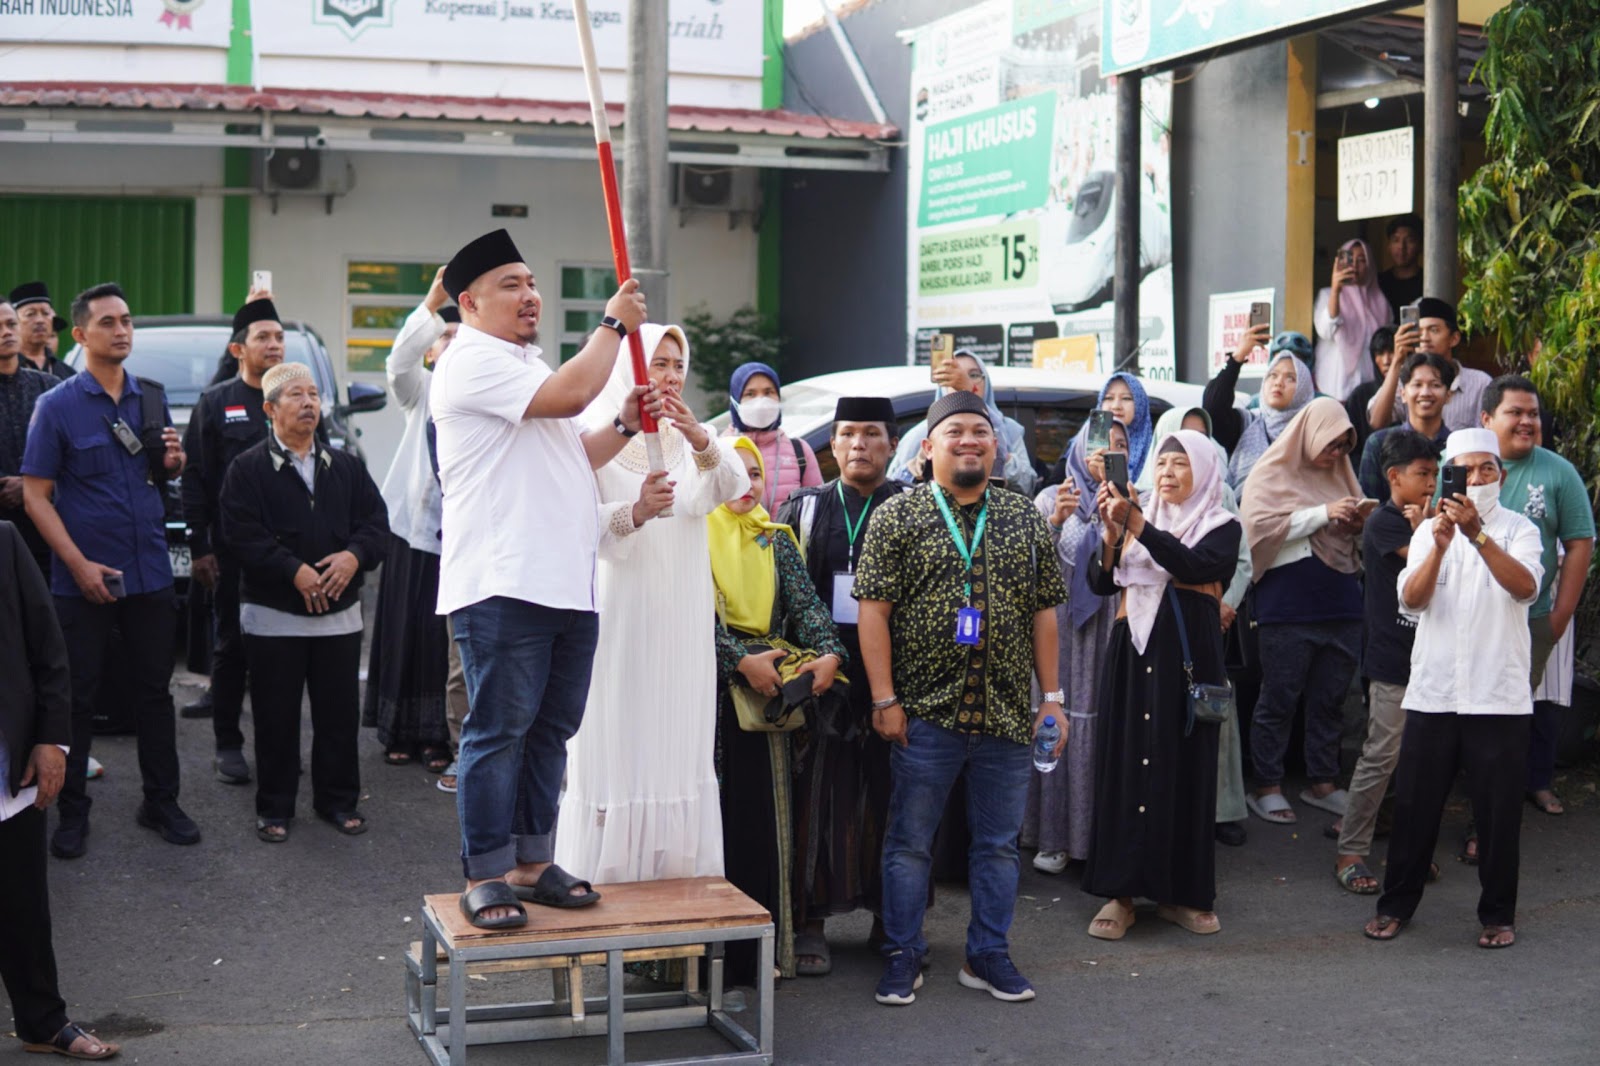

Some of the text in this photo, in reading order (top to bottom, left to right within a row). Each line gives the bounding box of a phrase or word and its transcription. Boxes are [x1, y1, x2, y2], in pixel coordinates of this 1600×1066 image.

[0, 0, 133, 17] RAH INDONESIA
[425, 0, 621, 28] Koperasi Jasa Keugan
[668, 13, 724, 40] riah
[928, 106, 1037, 162] HAJI KHUSUS
[1341, 131, 1411, 168] WARUNG
[1346, 168, 1398, 203] KOPI
[920, 240, 948, 256] DAFTAR
[1001, 234, 1026, 281] 15
[920, 271, 992, 289] KHUSUS MULAI DARI
